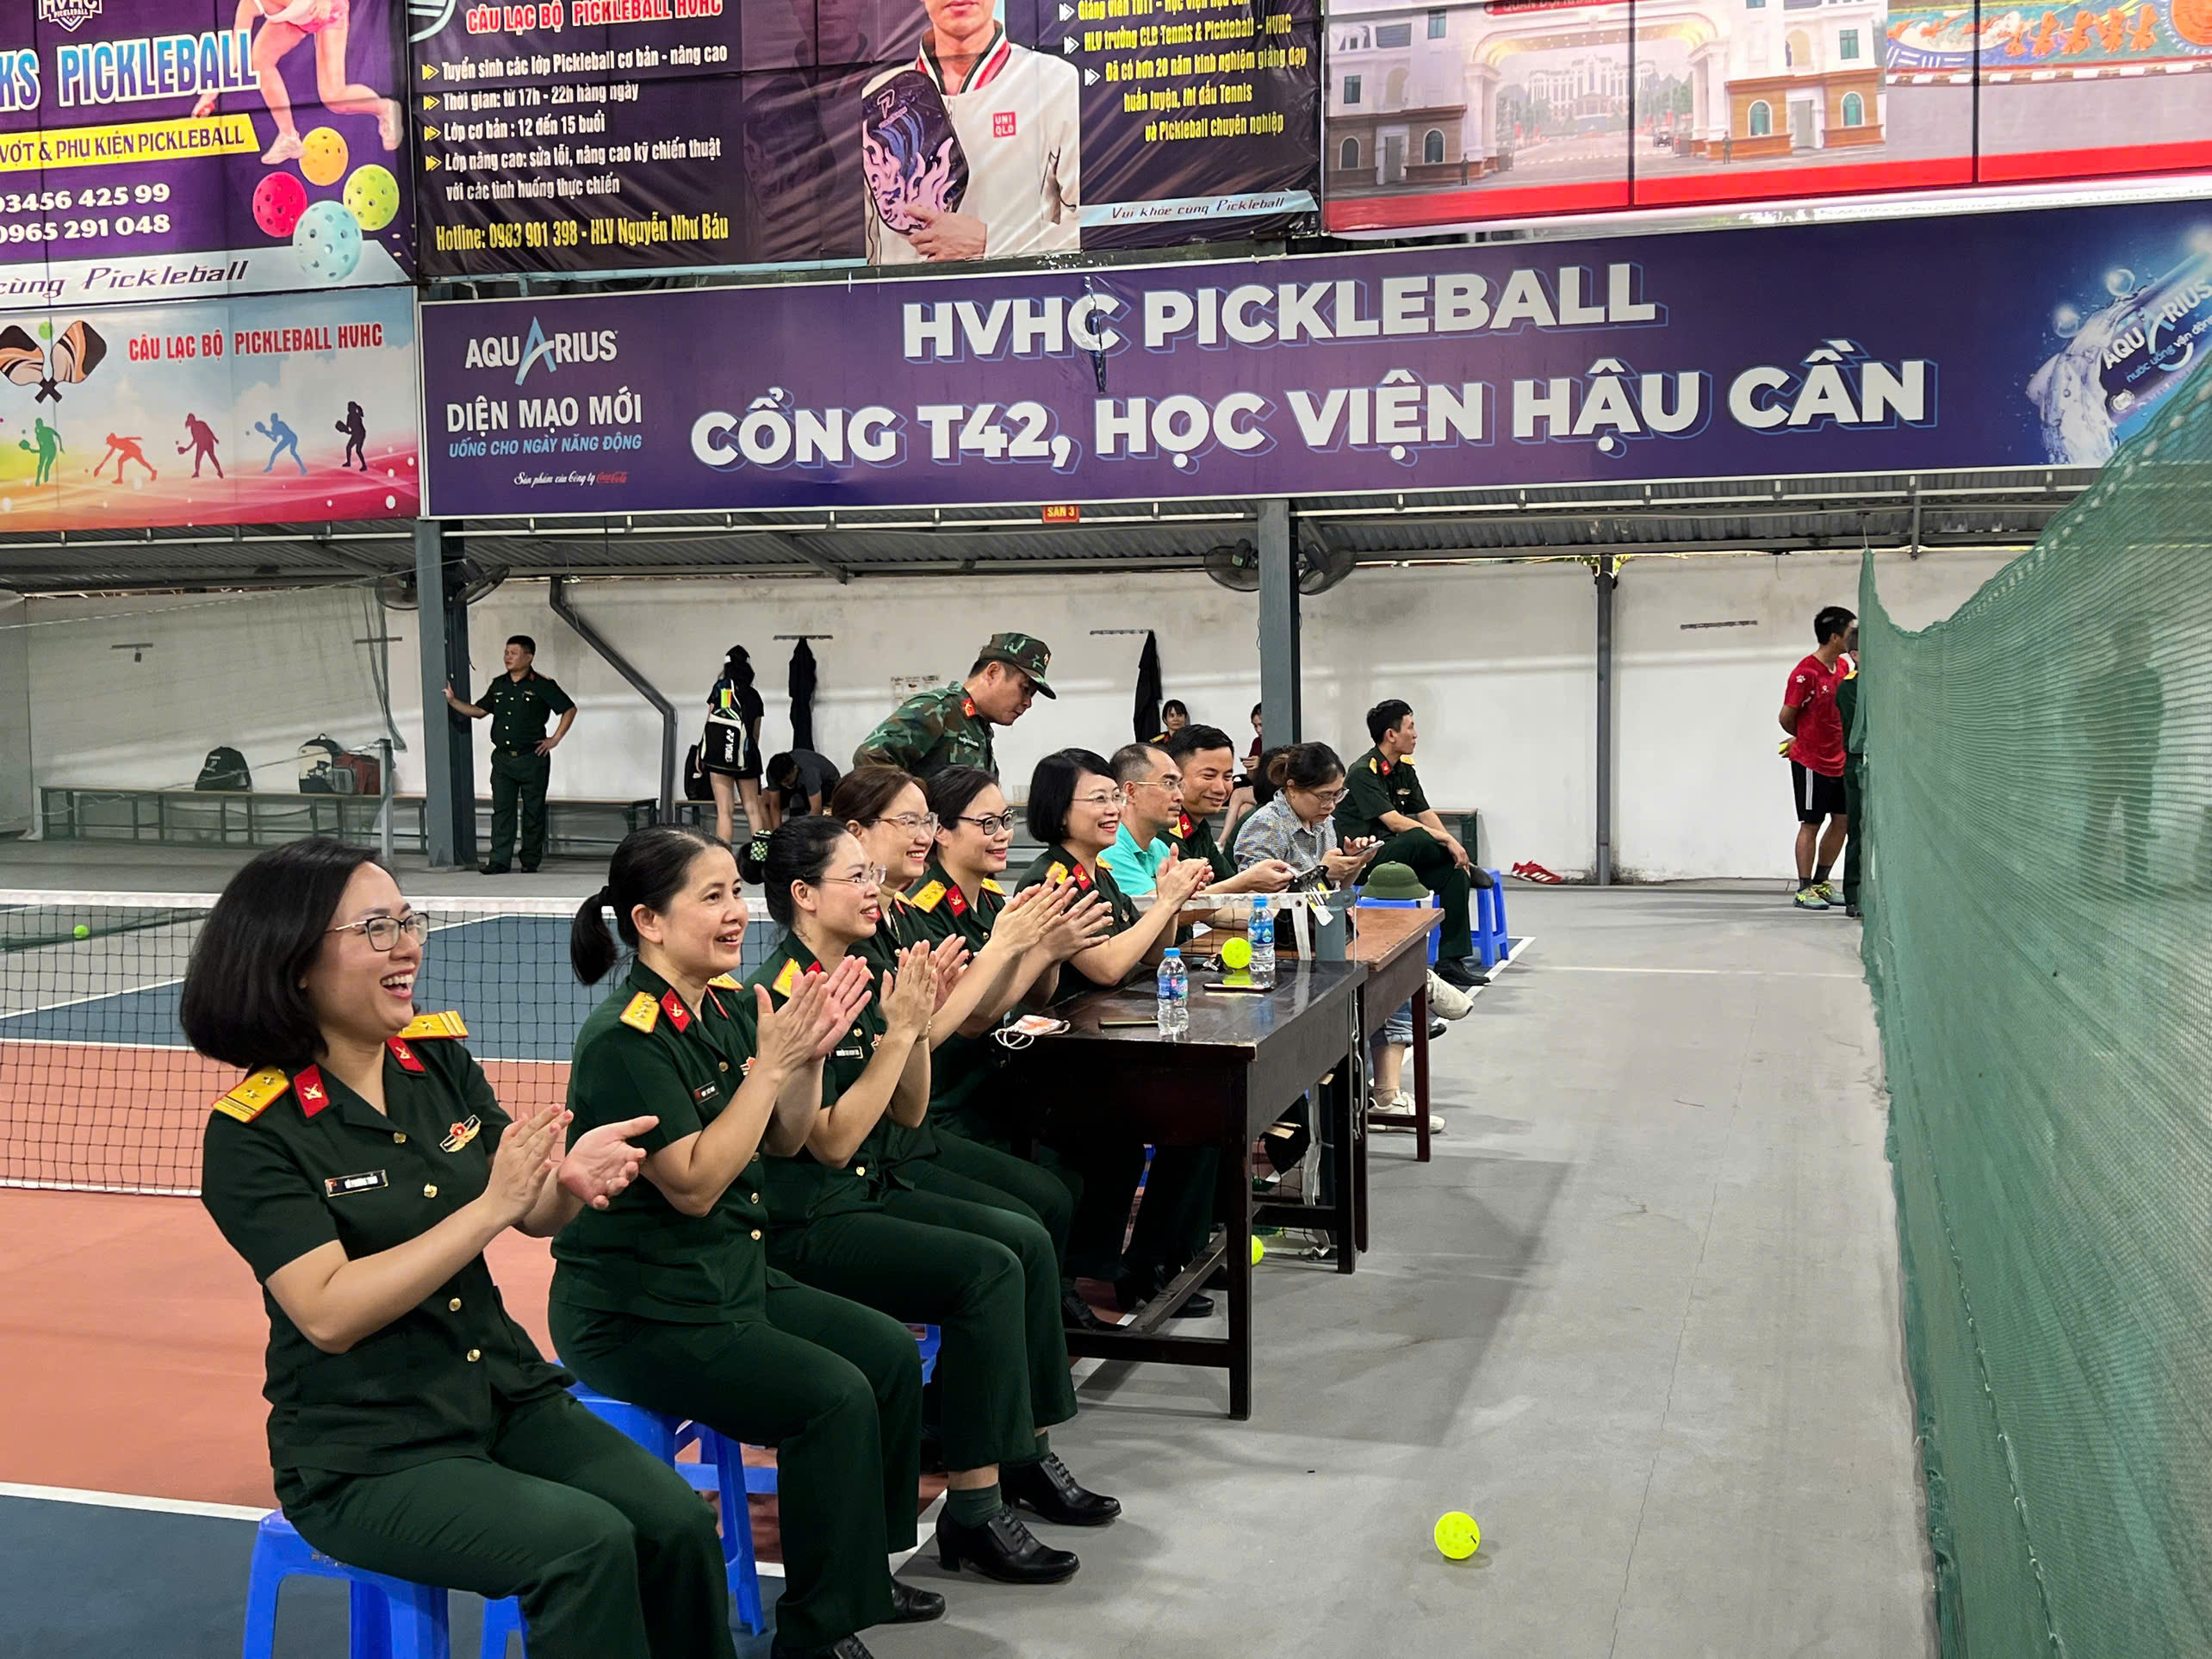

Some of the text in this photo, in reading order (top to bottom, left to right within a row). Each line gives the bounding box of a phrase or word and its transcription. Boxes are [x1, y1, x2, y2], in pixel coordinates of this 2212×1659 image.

[466, 3, 501, 34] CÂU
[504, 4, 536, 35] LẠC
[539, 0, 564, 33] BỘ
[572, 0, 673, 27] PICKLEBALL
[1084, 31, 1103, 52] HLV
[1104, 25, 1138, 50] trưởng
[1140, 27, 1159, 47] CLB
[1161, 22, 1193, 45] Tennis
[1196, 24, 1202, 42] &
[1204, 17, 1254, 41] Pickleball
[1265, 14, 1291, 34] HVHC
[57, 28, 260, 108] PICKLEBALL
[442, 57, 475, 82] Tuyển
[478, 62, 503, 79] sinh
[506, 57, 528, 77] các
[531, 54, 550, 76] lớp
[554, 51, 614, 73] Pickleball
[618, 51, 633, 69] cơ
[636, 46, 659, 68] bản
[670, 44, 701, 66] nâng
[704, 46, 727, 62] cao
[1105, 44, 1307, 83] Đã có hơn 20 năm kinh nghiệm giảng dạy
[443, 91, 468, 111] Thời
[471, 93, 501, 111] gian:
[503, 89, 516, 108] từ
[519, 88, 540, 106] 17h
[551, 85, 574, 104] 22h
[576, 84, 606, 105] hàng
[610, 82, 638, 103] ngày
[1124, 79, 1252, 112] huấn luyện, thi đấu Tennis
[444, 122, 465, 142] Lớp
[468, 121, 483, 139] cơ
[486, 120, 507, 139] bản
[518, 118, 532, 136] 12
[535, 113, 558, 136] đến
[561, 115, 575, 134] 15
[578, 109, 605, 133] buổi
[994, 115, 1013, 125] UNI
[995, 126, 1015, 135] QLO
[1145, 110, 1284, 142] và Pickleball chuyên nghiệp
[0, 126, 245, 166] VỢT & PHỤ KIỆN PICKLEBALL
[444, 135, 721, 172] Lớp nâng cao: sửa lỗi, nâng cao kỹ chiến thuật
[78, 186, 129, 208] 425
[134, 183, 171, 204] 99
[446, 171, 619, 202] với các tình huống thực chiến
[1112, 206, 1134, 220] Vui
[1177, 204, 1209, 220] cùng
[1216, 196, 1285, 212] Pickleball
[64, 218, 109, 239] 291
[115, 214, 171, 236] 048
[436, 224, 486, 251] Hotline:
[489, 221, 521, 249] 0983
[525, 221, 549, 247] 901
[553, 221, 578, 246] 398
[591, 218, 614, 245] HLV
[618, 211, 668, 246] Nguyễn
[671, 214, 700, 241] Như
[702, 212, 729, 240] Báu
[83, 260, 248, 289] Pickleball
[903, 263, 1659, 359] HVHC PICKLEBALL
[128, 322, 382, 364] CÂU LẠC BỘ PICKLEBALL HVHC
[464, 316, 618, 386] AQUARIUS
[446, 386, 642, 438] DIỆN MẠO MỚI
[691, 340, 1924, 469] CỔNG T42, HỌC VIỆN HẬU CẦN
[449, 432, 642, 458] UỐNG CHO NGÀY NĂNG ĐỘNG
[1068, 506, 1075, 517] 3
